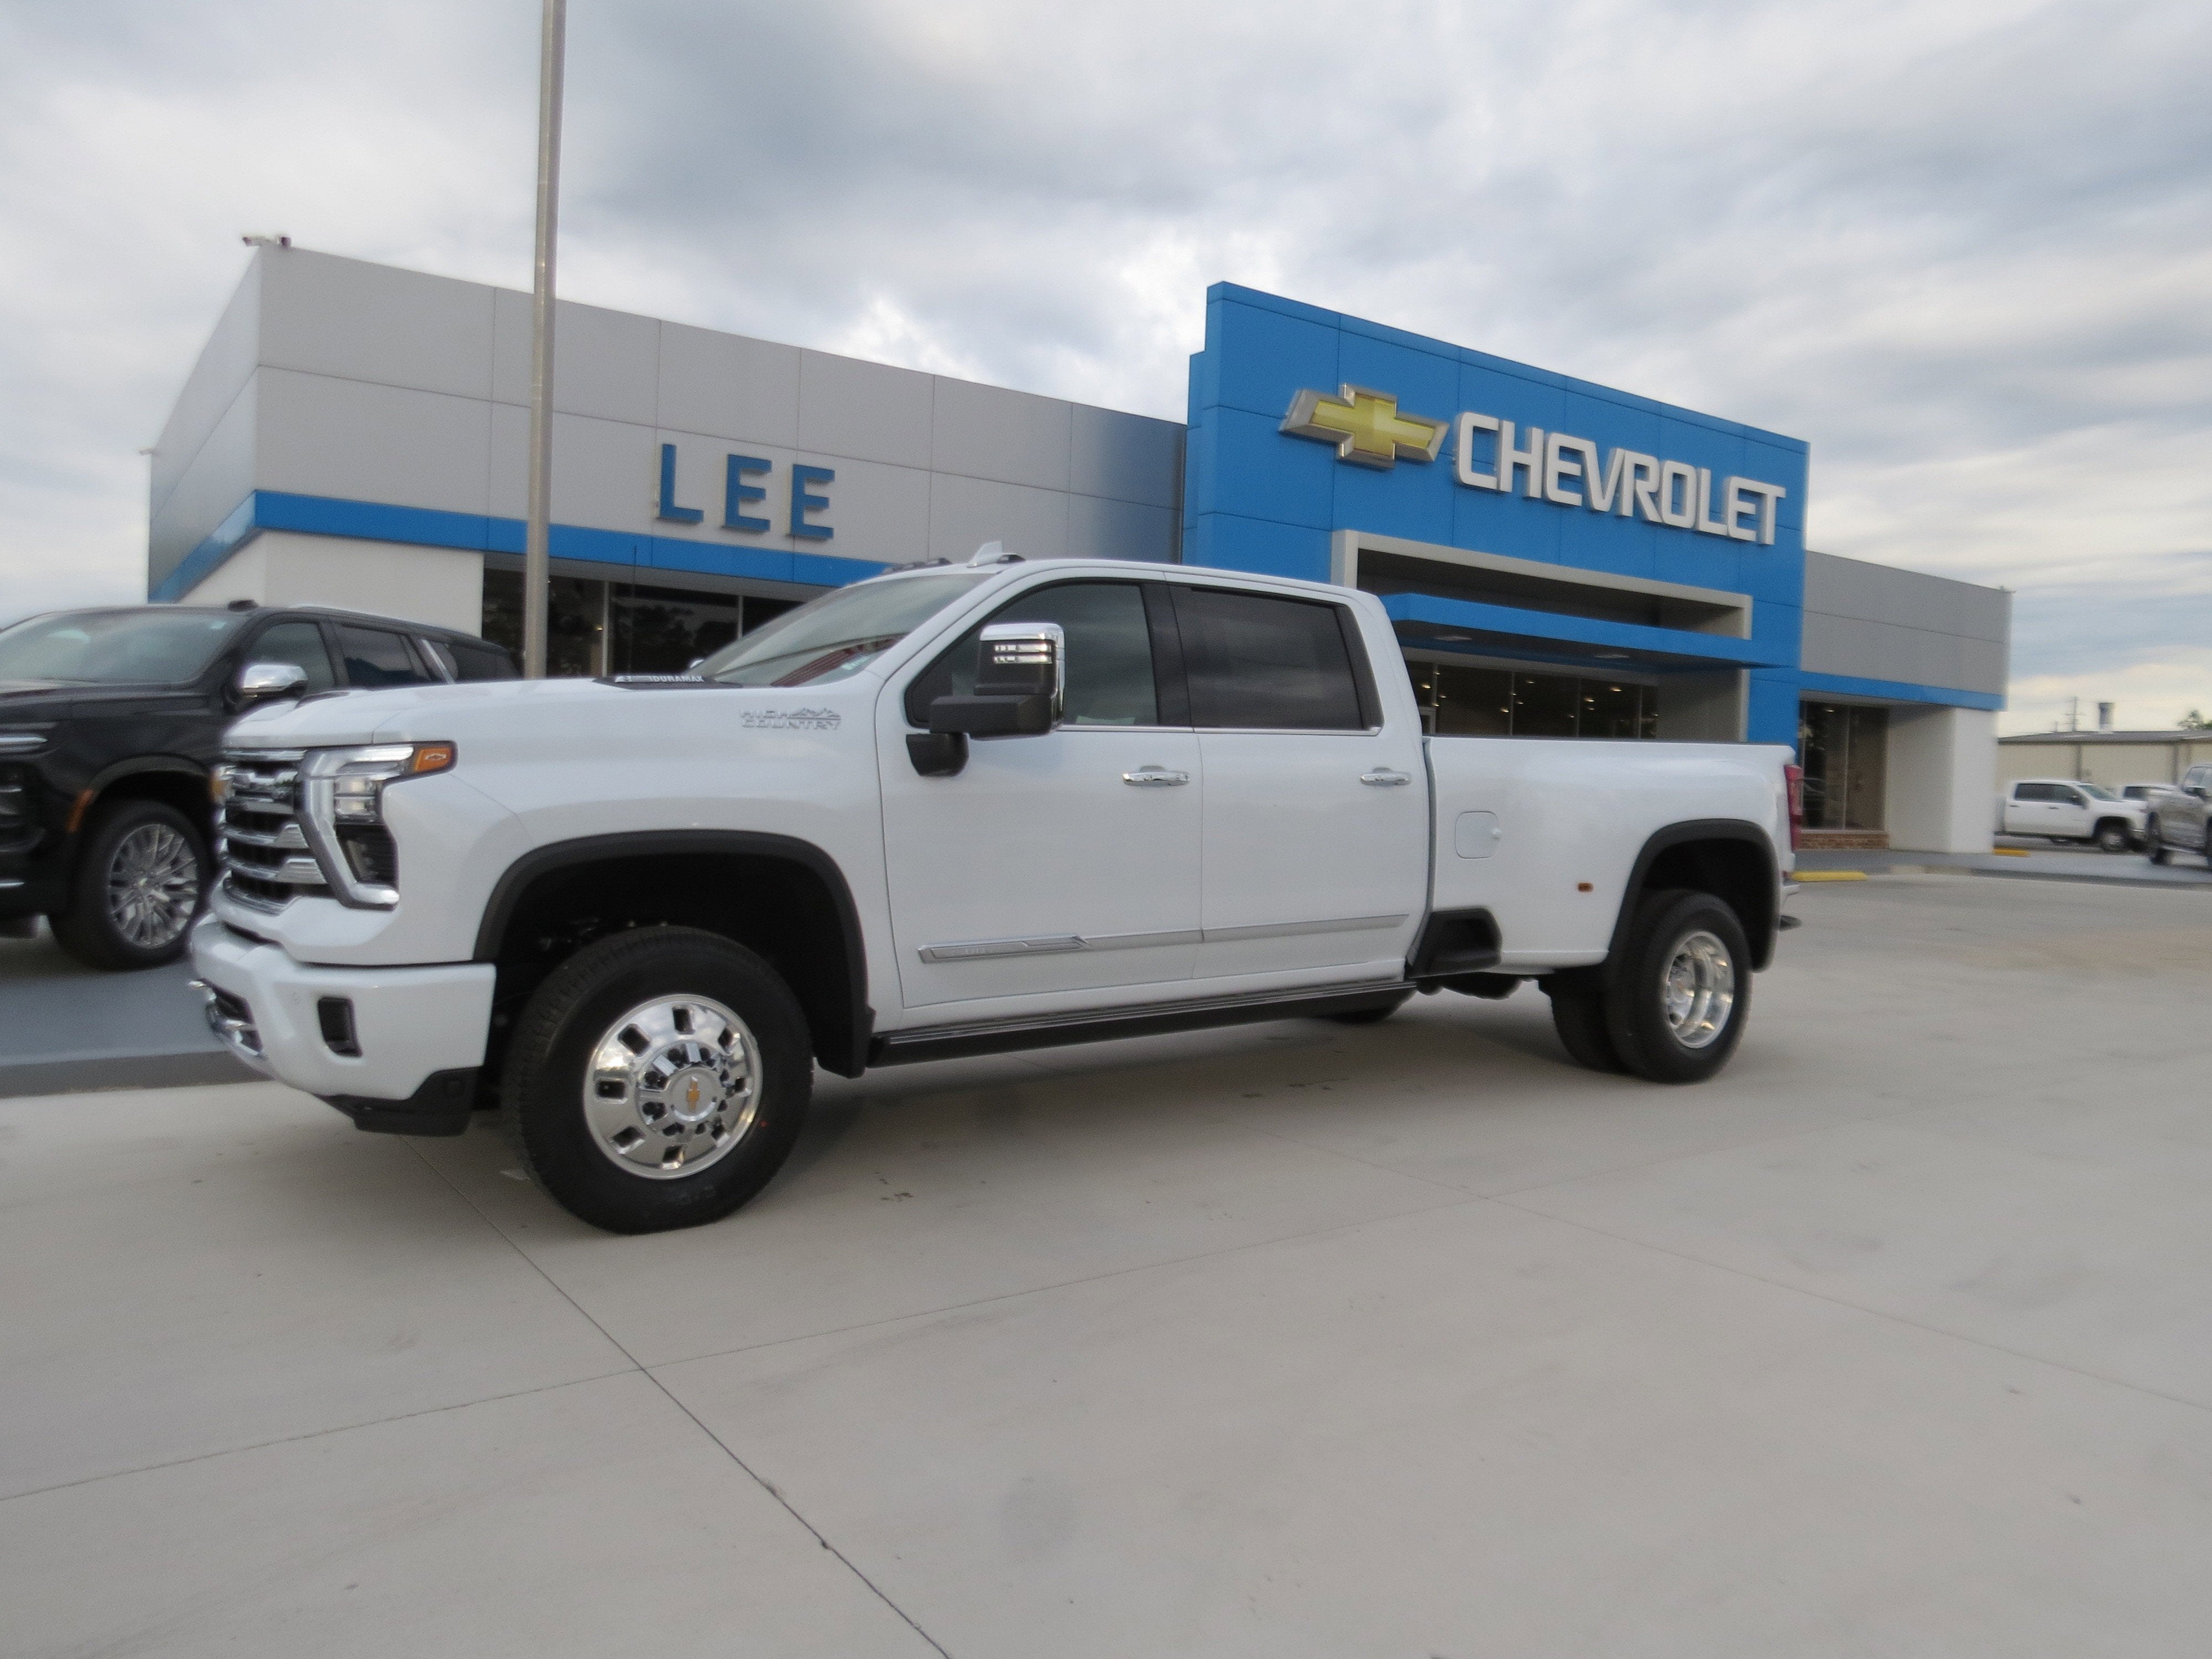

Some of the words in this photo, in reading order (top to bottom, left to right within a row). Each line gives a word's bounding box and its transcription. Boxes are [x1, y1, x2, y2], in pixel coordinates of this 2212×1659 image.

[659, 444, 835, 539] LEE
[1455, 411, 1786, 545] CHEVROLET
[742, 719, 841, 731] COUNTRY
